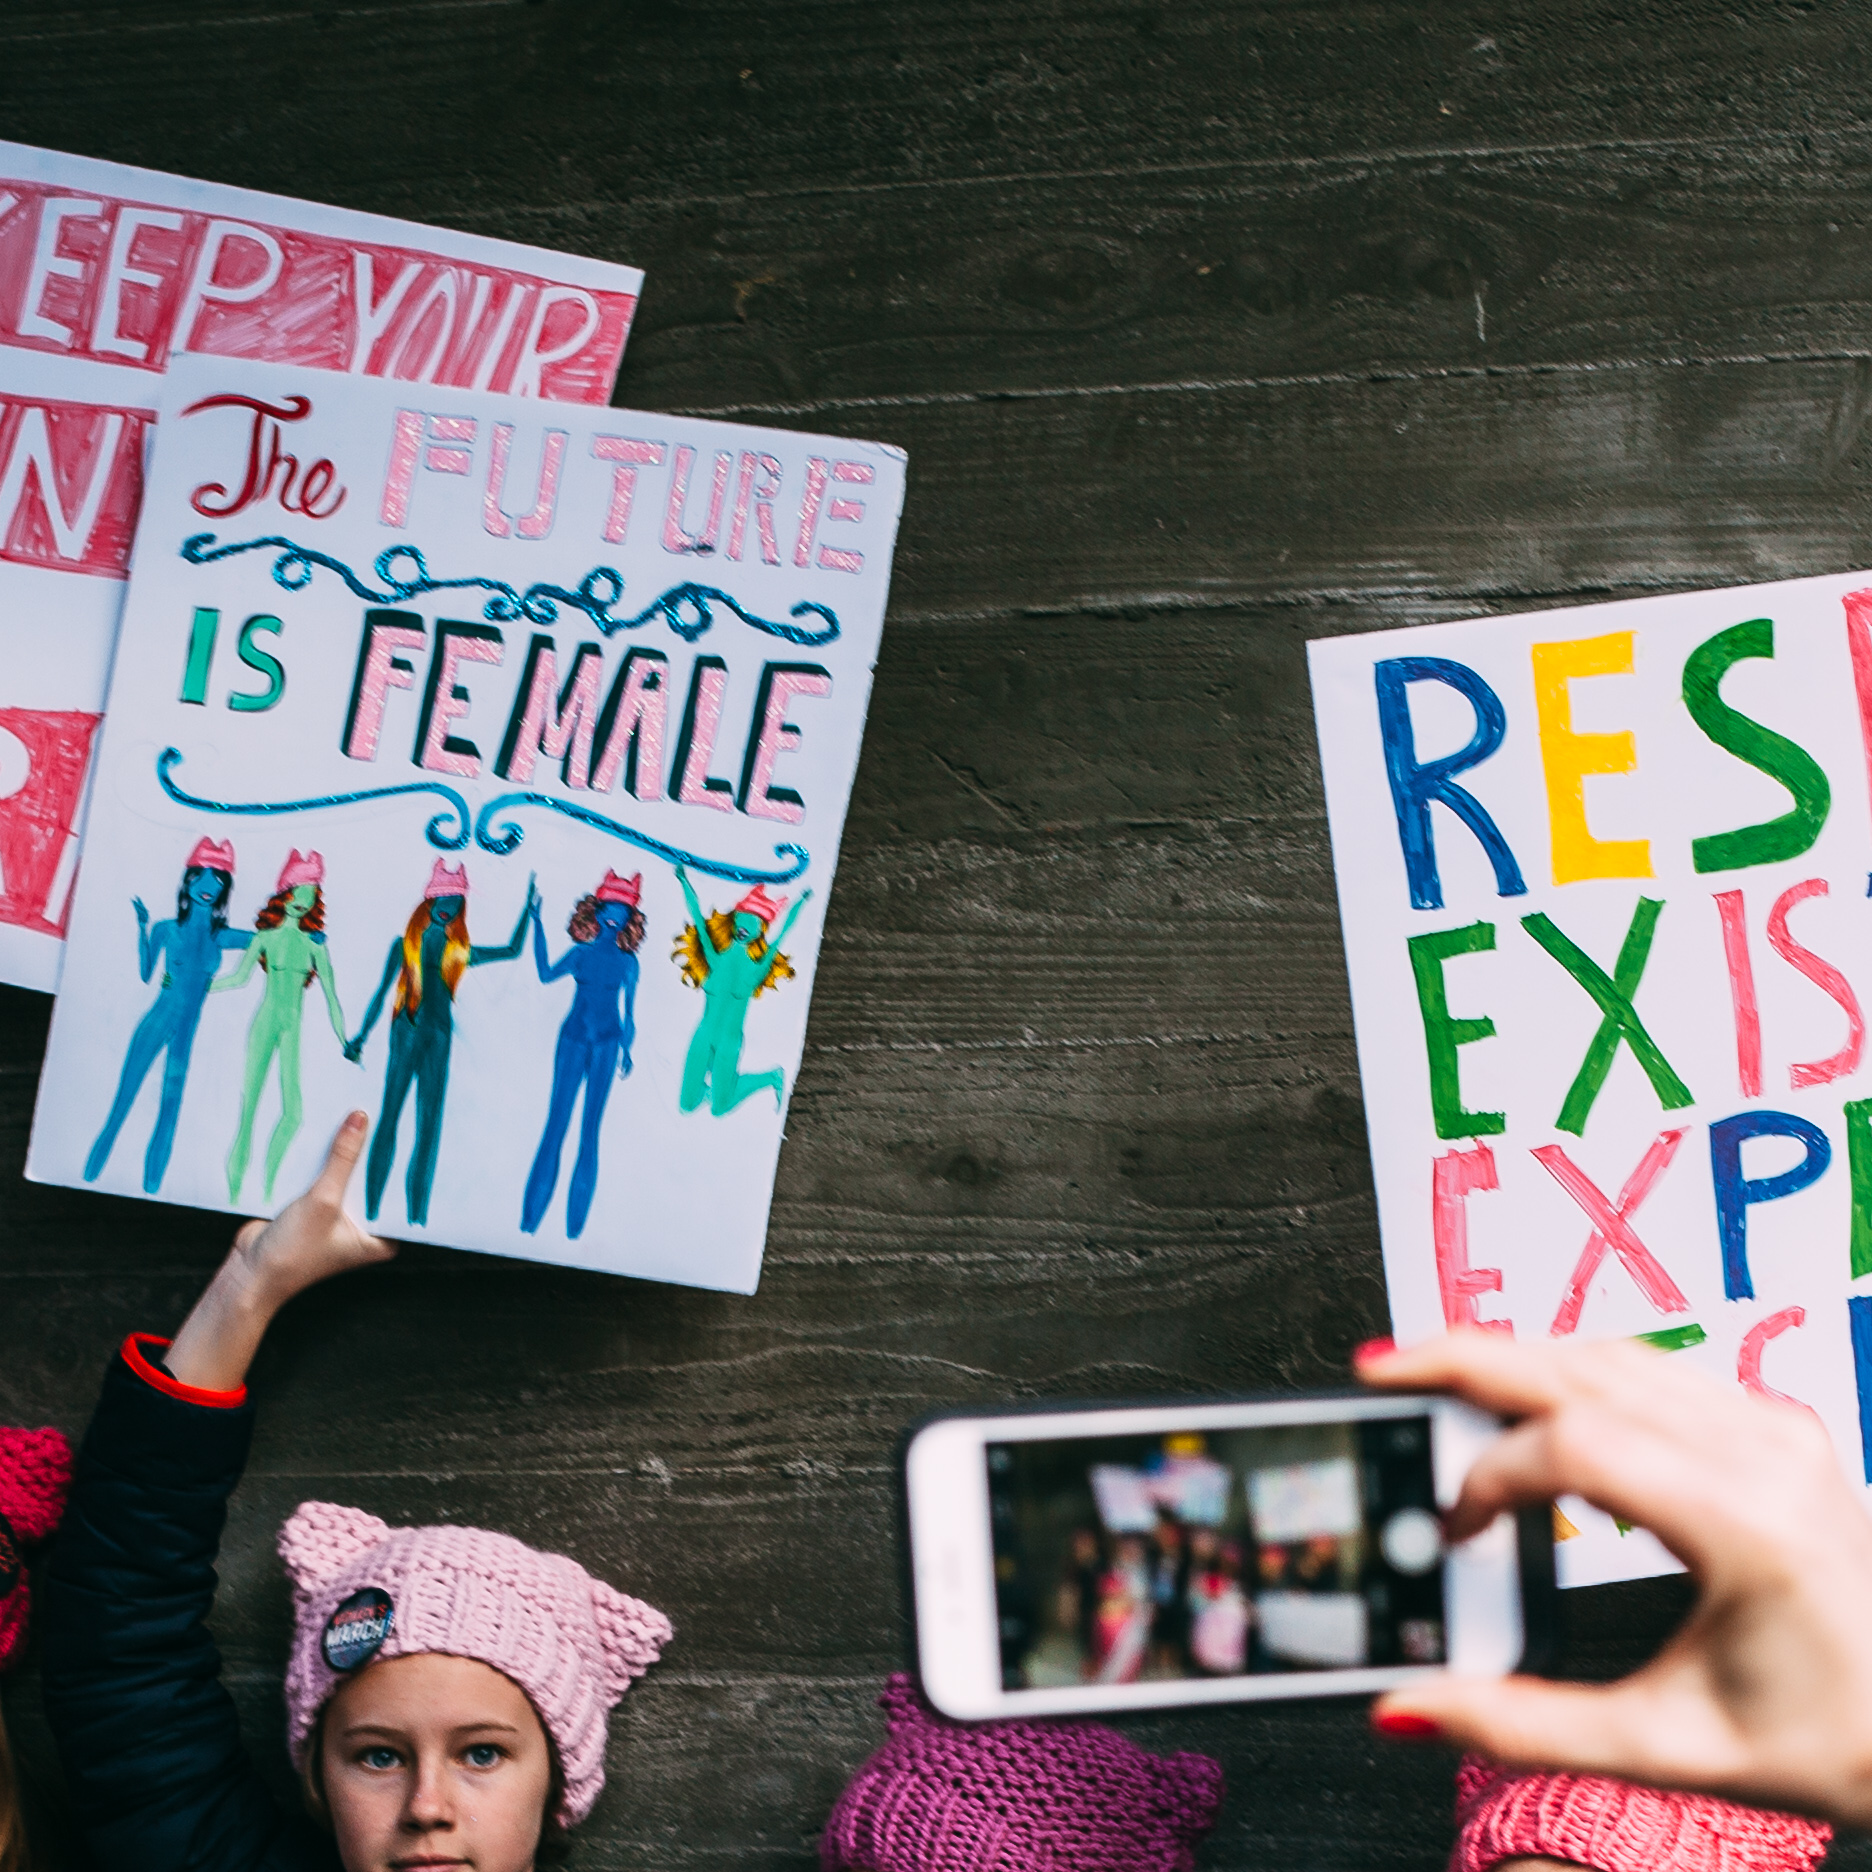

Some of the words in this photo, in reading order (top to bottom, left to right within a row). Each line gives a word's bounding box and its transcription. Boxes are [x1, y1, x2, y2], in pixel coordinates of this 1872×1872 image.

[179, 392, 349, 520] The
[378, 407, 876, 575] FUTURE
[179, 606, 288, 713] IS
[340, 608, 834, 827] FEMALE
